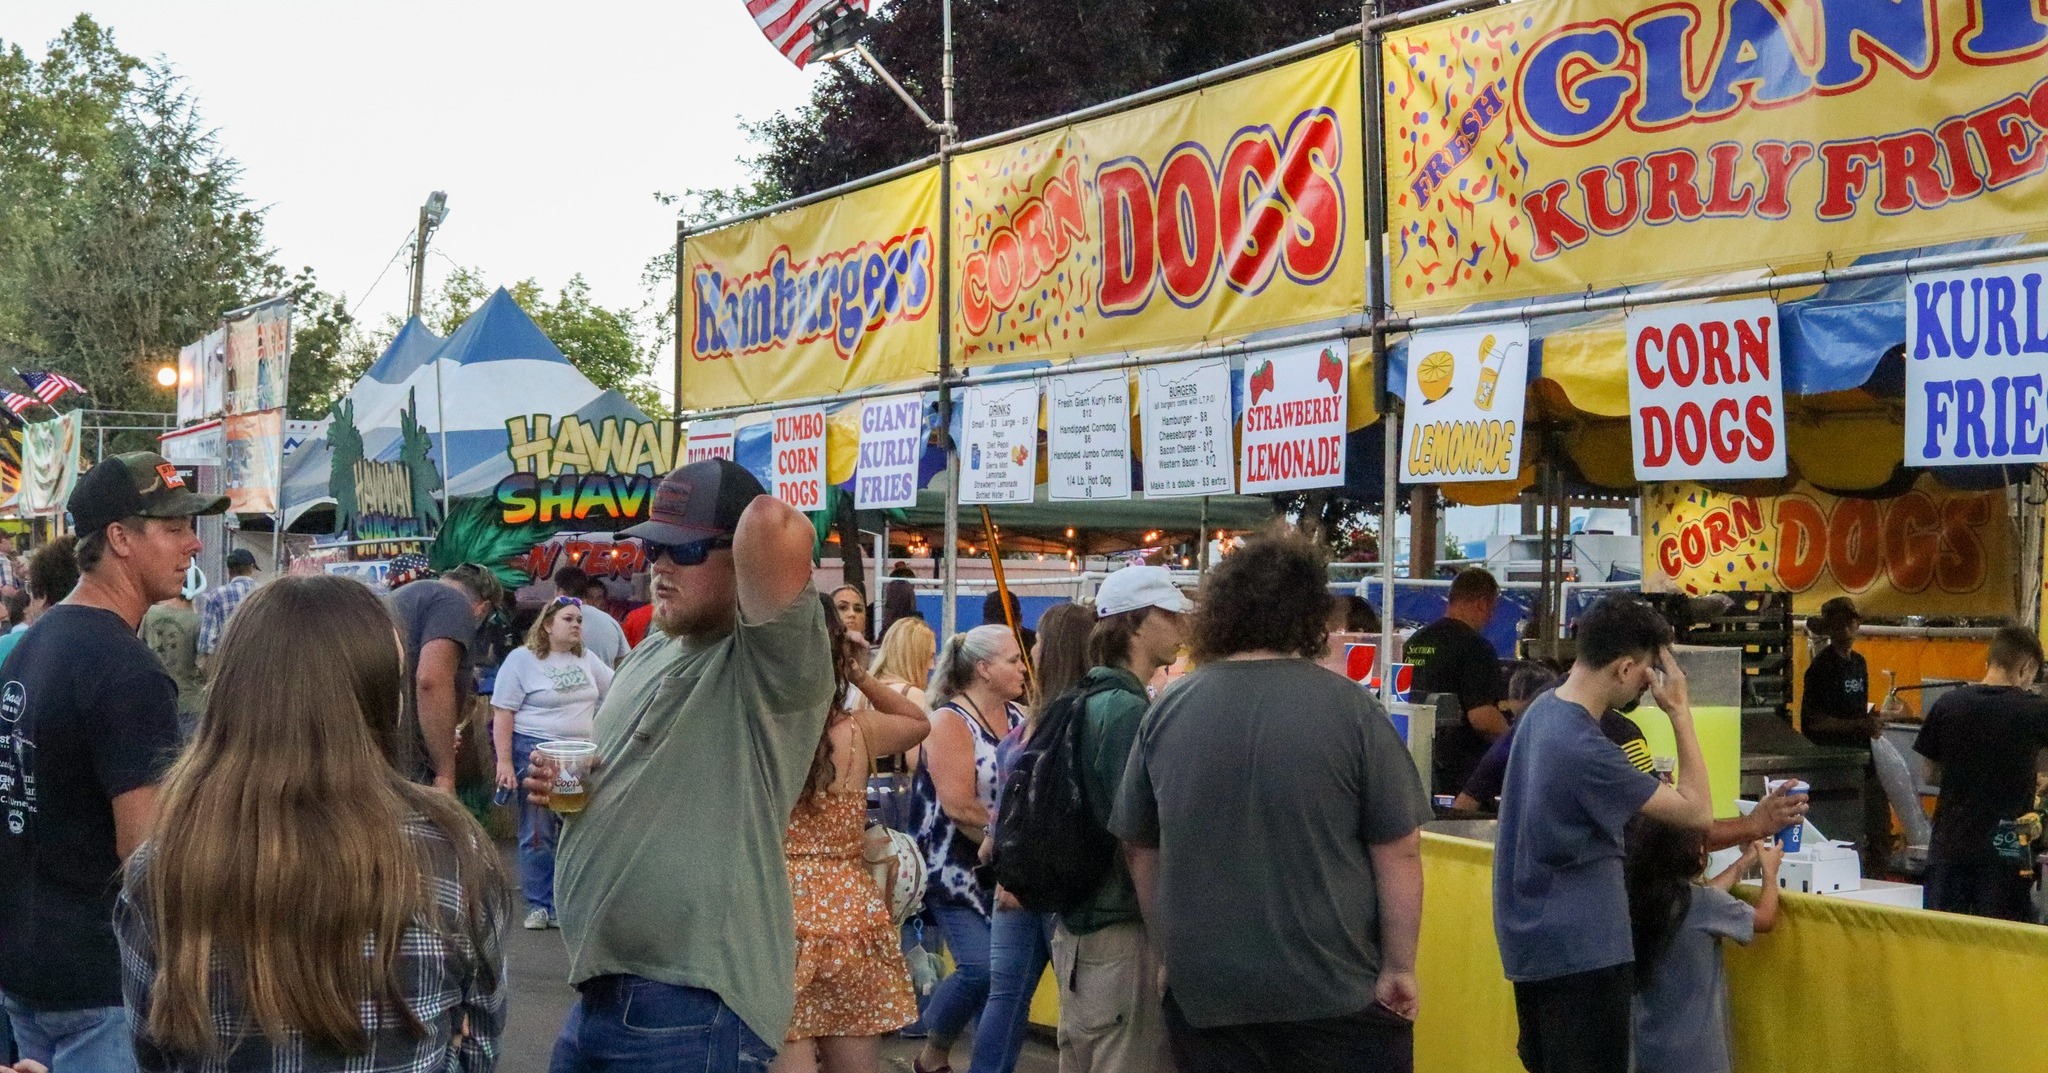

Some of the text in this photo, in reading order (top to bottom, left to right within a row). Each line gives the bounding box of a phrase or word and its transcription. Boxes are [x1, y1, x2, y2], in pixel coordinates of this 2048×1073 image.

[1410, 81, 1507, 210] FRESH
[1522, 139, 1814, 264] KURLY
[961, 106, 1345, 336] CORN DOGS
[692, 225, 935, 362] Hamburgers
[1636, 316, 1771, 390] CORN
[1058, 395, 1123, 408] Fresh Giant Kurly Fries
[1169, 384, 1198, 398] BURGERS
[862, 402, 920, 434] GIANT
[989, 404, 1011, 417] DRINKS
[1083, 410, 1092, 418] $12
[1162, 415, 1193, 426] Hamburger
[1247, 396, 1342, 433] STRAWBERRY
[1923, 373, 2048, 459] FRIE
[774, 412, 823, 444] JUMBO
[1060, 423, 1117, 436] Handipped Corndog
[1159, 428, 1197, 441] Cheeseburger
[1205, 426, 1213, 438] $9
[1639, 395, 1774, 468] DOGS
[504, 413, 684, 481] HAWAI
[779, 447, 819, 476] CORN
[859, 437, 918, 469] KURLY
[1054, 448, 1124, 461] Handipped Jumbo Corndog
[1159, 459, 1182, 469] Western
[1182, 458, 1199, 468] Bacon
[1206, 454, 1217, 468] $12
[1160, 445, 1176, 455] Bacon
[1177, 443, 1196, 454] Cheese
[1203, 440, 1214, 454] $12
[1247, 436, 1341, 483] LEMONADE
[1408, 419, 1515, 477] LEMONADE
[780, 480, 819, 507] DOGS
[860, 473, 913, 504] FRIES
[1067, 477, 1076, 486] 1/4
[1088, 475, 1098, 485] Hot
[1100, 475, 1112, 487] Dog
[1150, 481, 1165, 491] Make
[1178, 478, 1196, 489] double
[1202, 477, 1210, 487] $3
[1211, 477, 1227, 486] extra
[492, 472, 662, 524] SHAV
[1658, 489, 1991, 595] CORN DOGS
[552, 671, 588, 690] 2022
[555, 777, 582, 788] Coors
